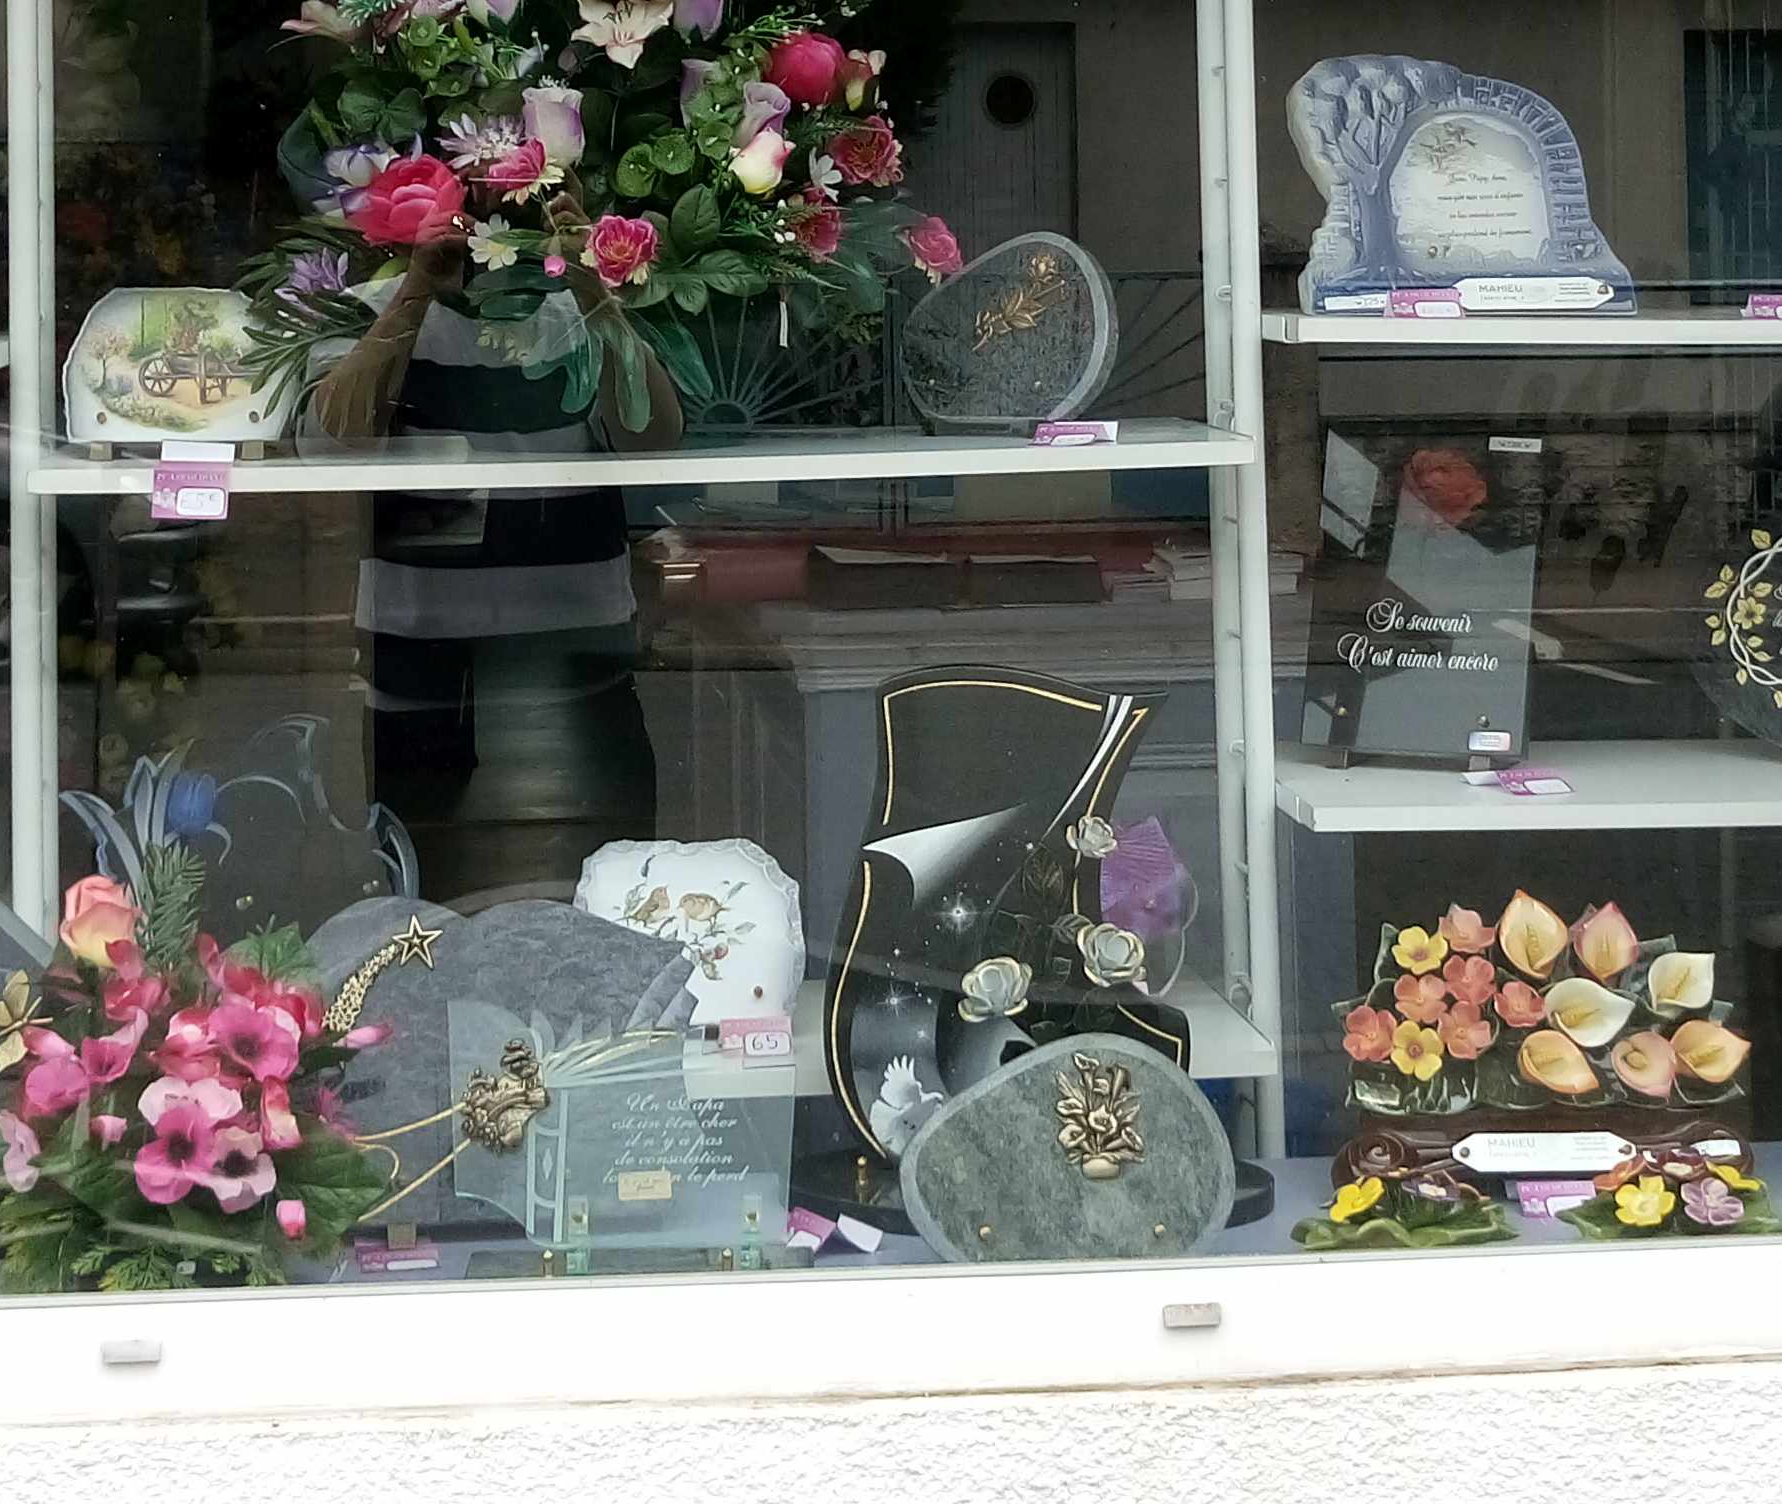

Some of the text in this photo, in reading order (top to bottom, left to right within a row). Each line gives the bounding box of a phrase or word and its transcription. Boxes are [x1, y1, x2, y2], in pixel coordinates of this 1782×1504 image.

[1366, 598, 1473, 632] Se souvenir
[1337, 633, 1499, 673] C'est aimer encore
